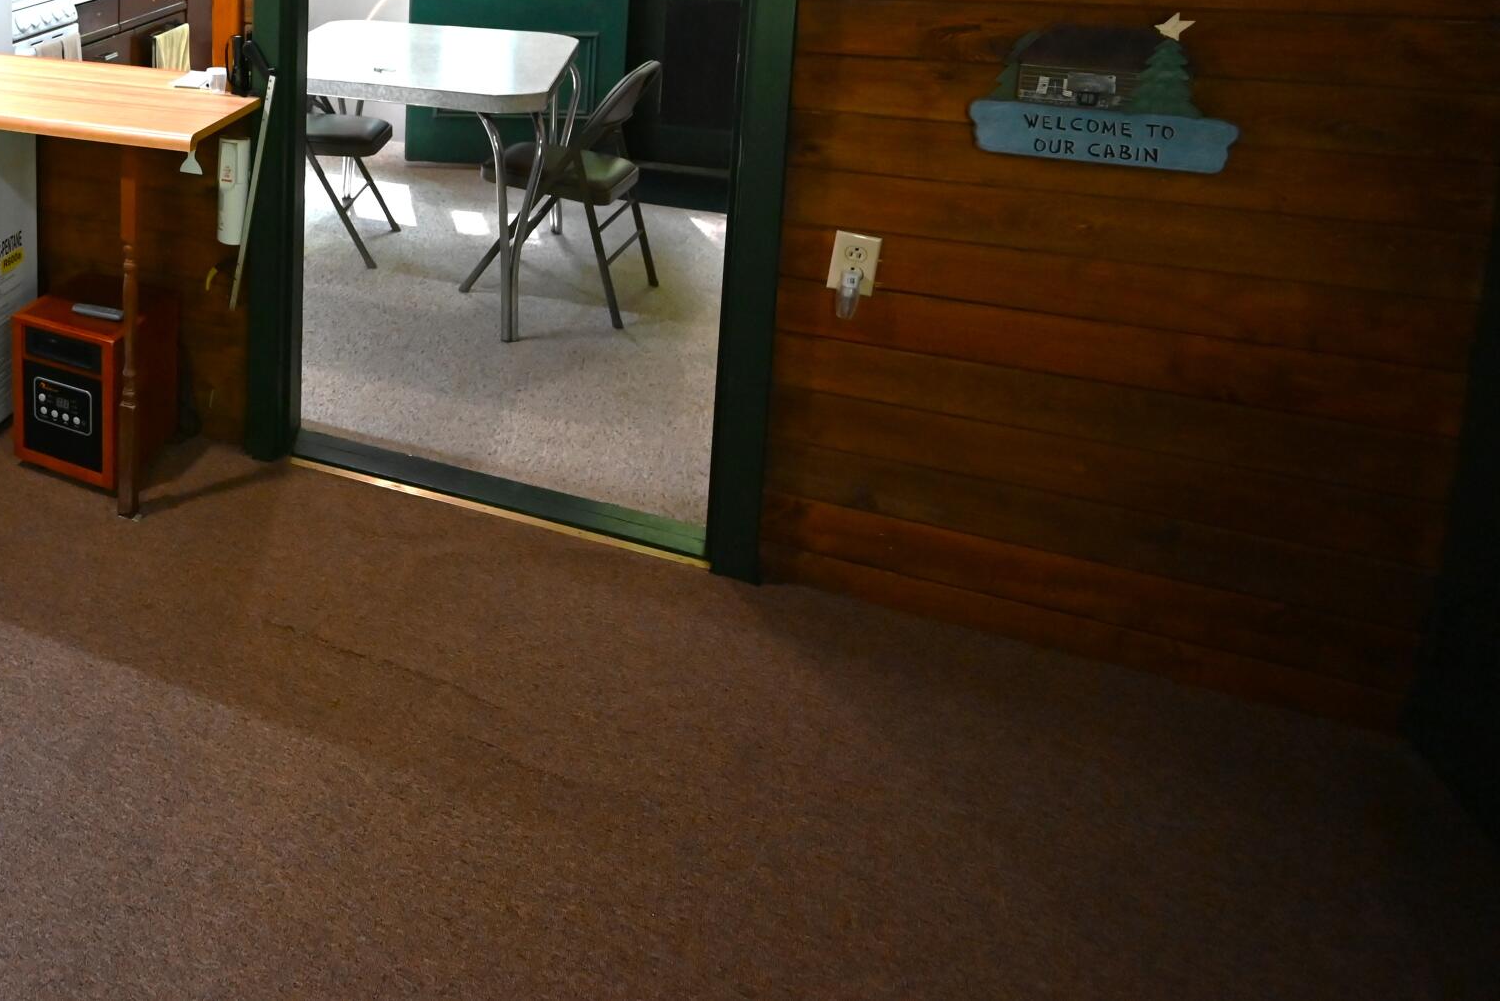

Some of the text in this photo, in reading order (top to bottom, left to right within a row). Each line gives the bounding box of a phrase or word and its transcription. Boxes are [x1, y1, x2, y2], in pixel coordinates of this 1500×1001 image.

[1023, 113, 1175, 141] WELCOME TO
[1033, 138, 1160, 163] OUR CABIN
